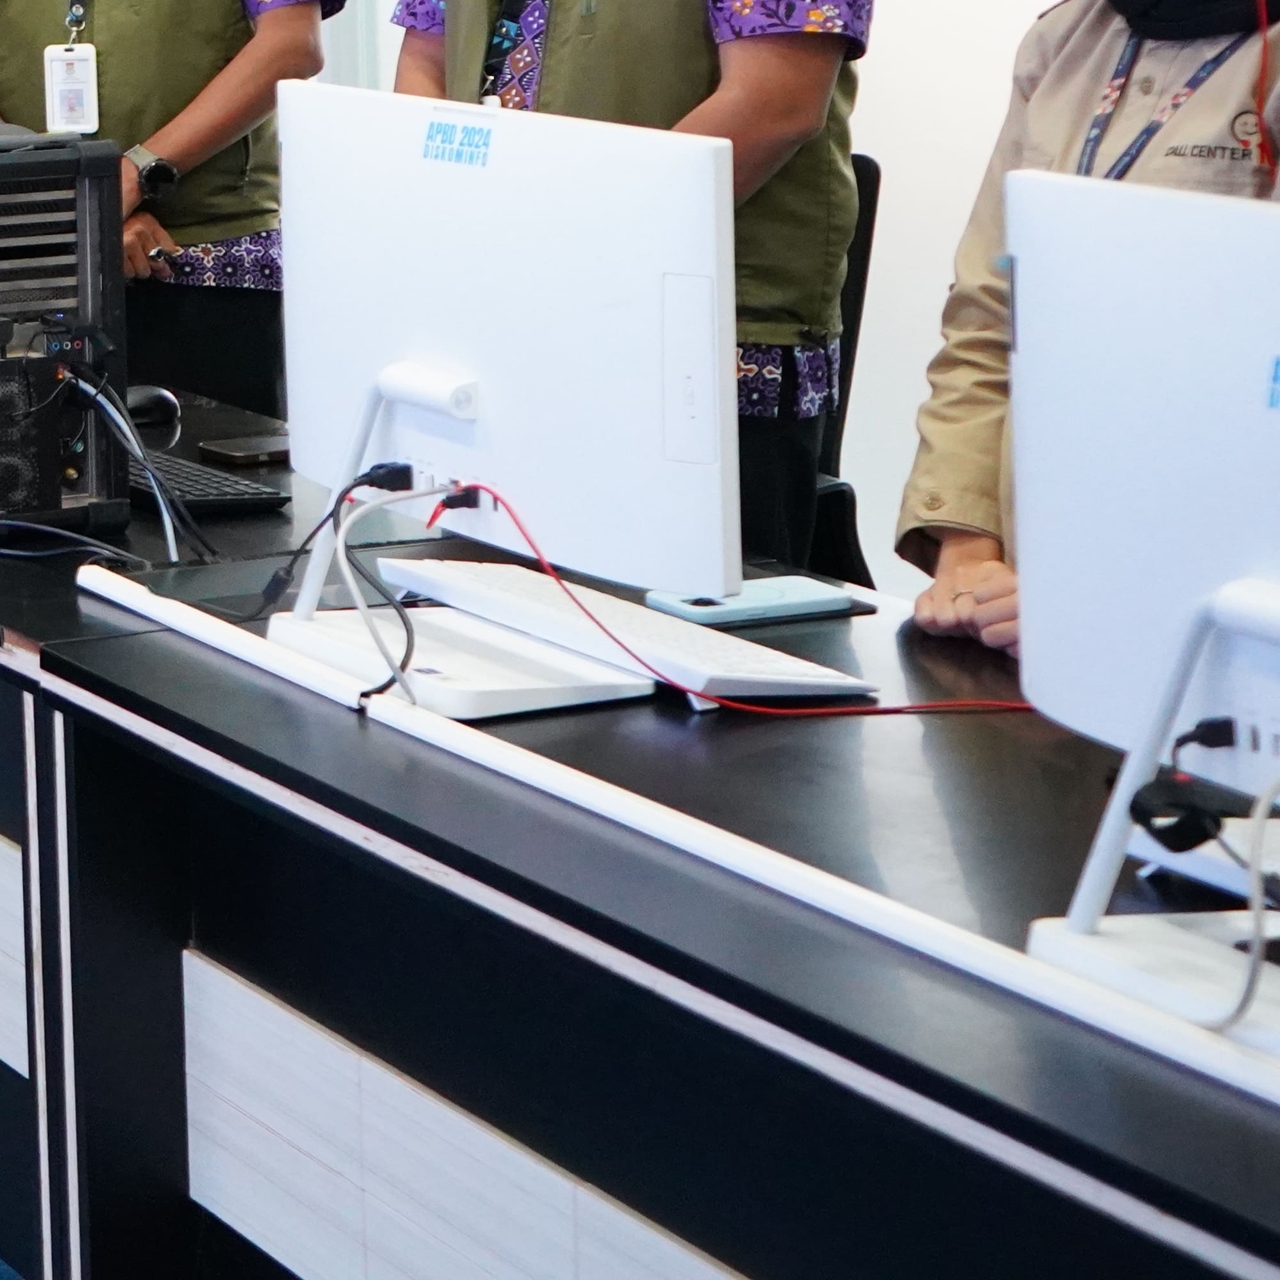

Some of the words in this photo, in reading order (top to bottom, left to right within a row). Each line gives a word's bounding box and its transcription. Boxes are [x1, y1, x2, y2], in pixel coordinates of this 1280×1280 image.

[426, 121, 458, 145] APBD
[459, 125, 492, 150] 2024
[423, 143, 489, 167] DISKOMINFO
[1190, 144, 1252, 160] CENTER
